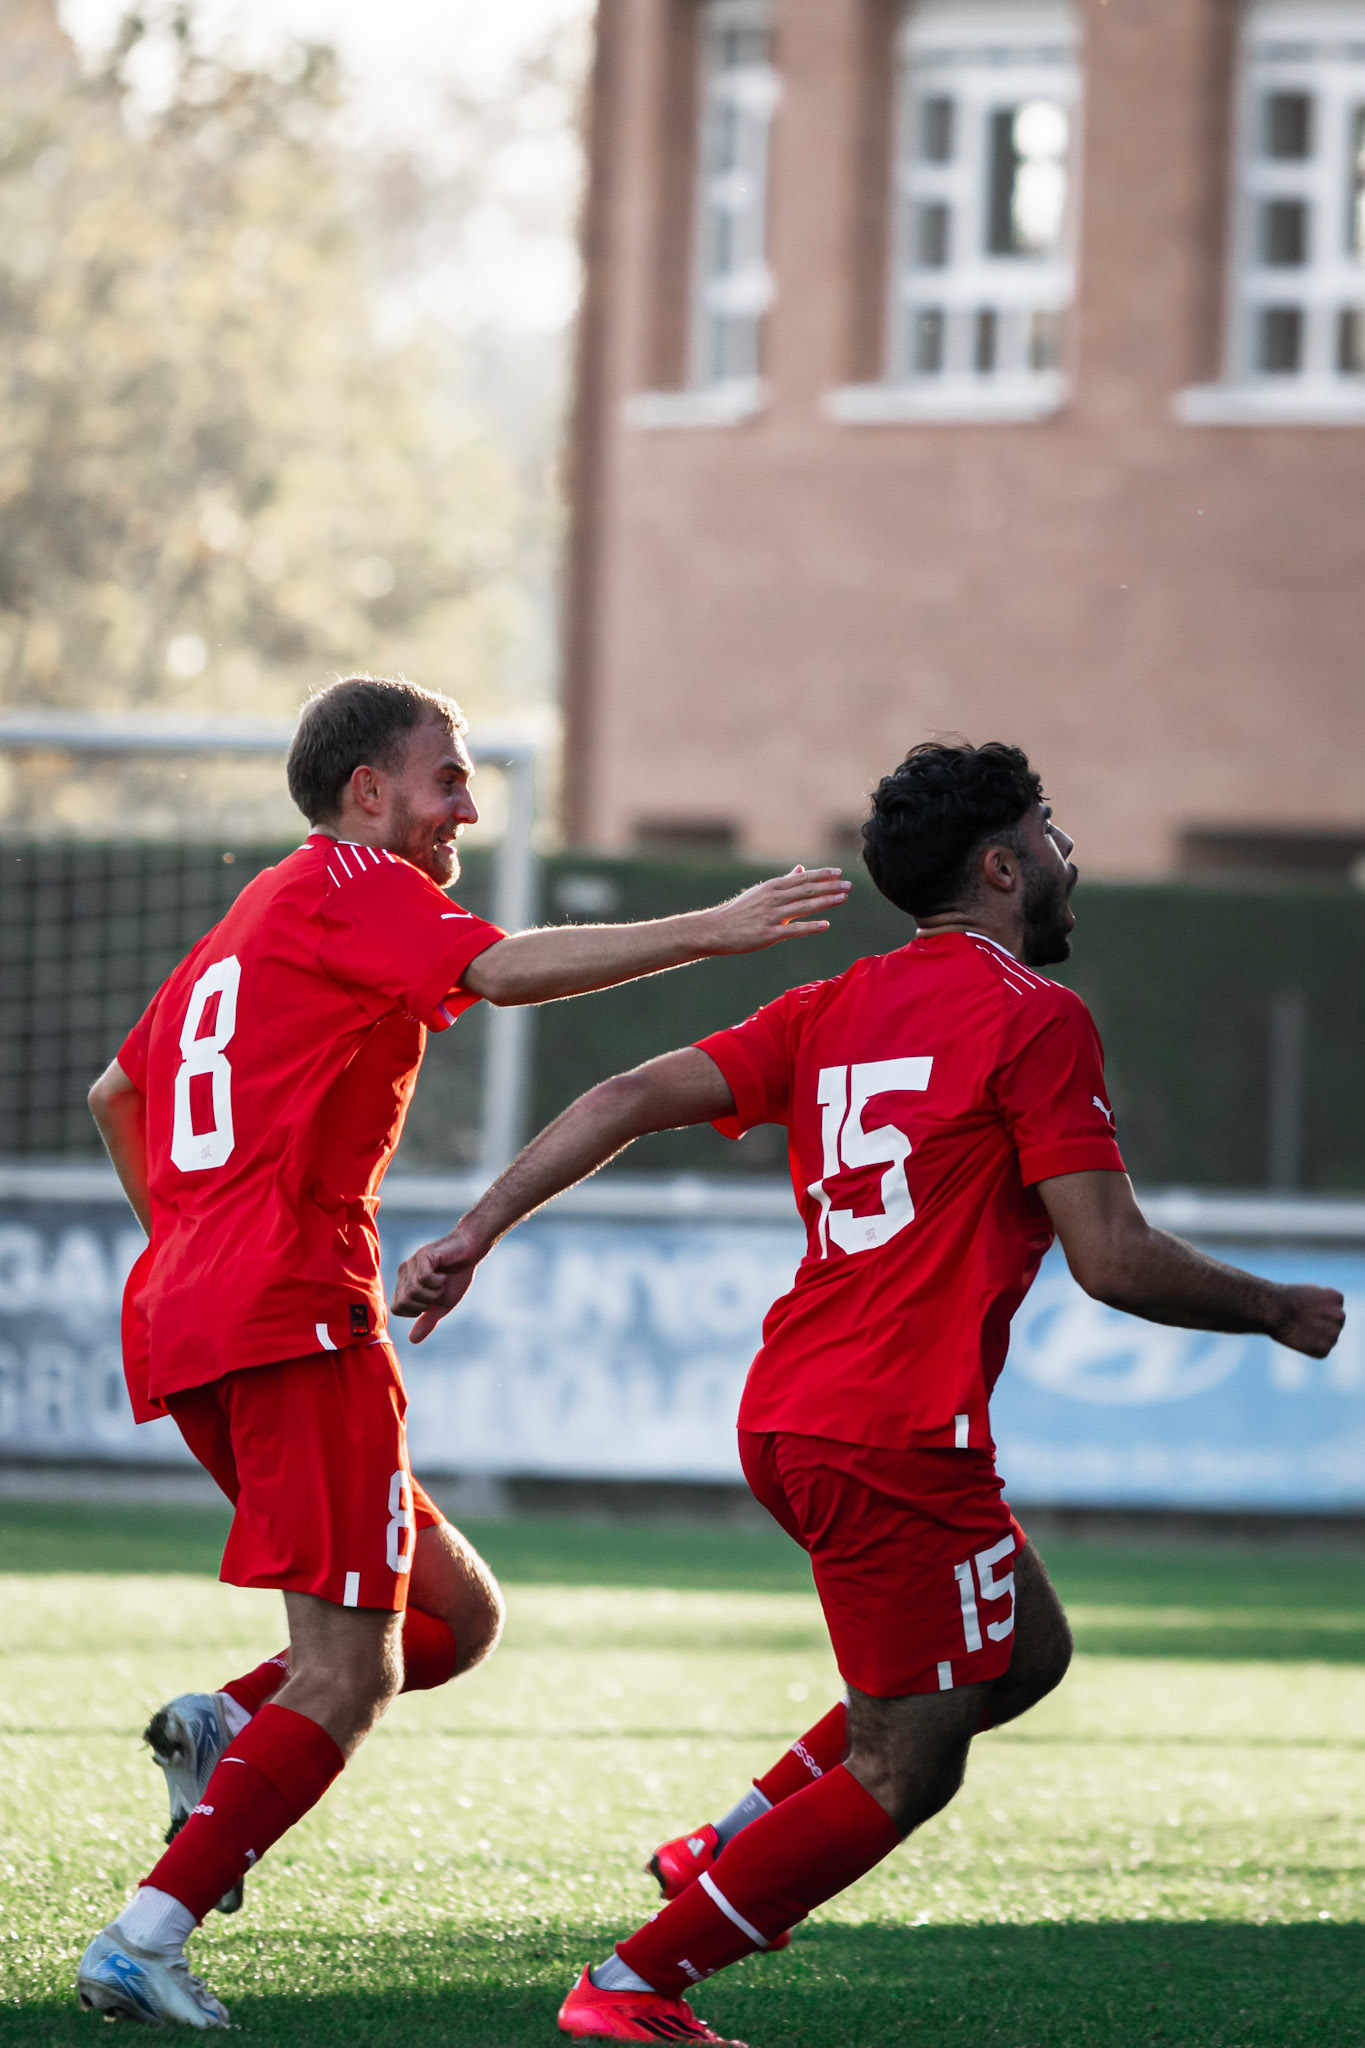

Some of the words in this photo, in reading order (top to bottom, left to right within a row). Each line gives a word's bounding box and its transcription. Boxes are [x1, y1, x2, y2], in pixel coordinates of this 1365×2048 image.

[170, 955, 241, 1172] 8
[807, 1056, 934, 1260] 15
[386, 1469, 417, 1574] 8
[954, 1533, 1016, 1653] 15
